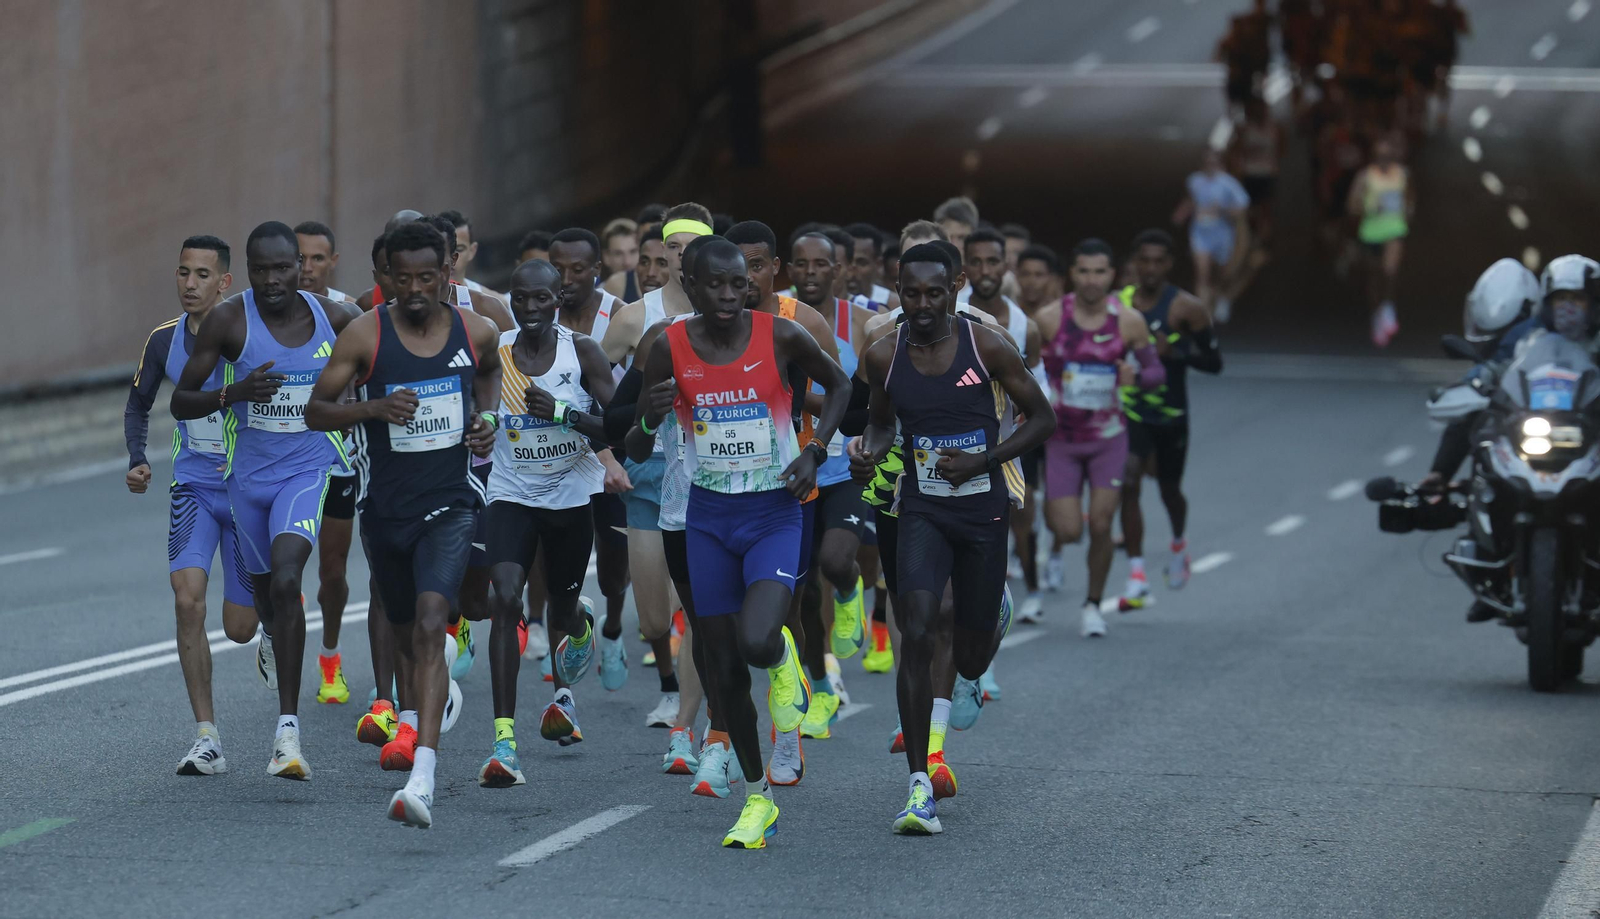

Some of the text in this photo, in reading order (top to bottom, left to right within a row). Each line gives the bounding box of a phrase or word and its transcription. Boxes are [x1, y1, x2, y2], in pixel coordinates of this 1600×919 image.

[696, 387, 758, 406] SEVILLA
[421, 406, 432, 415] 25
[716, 407, 758, 419] ZURICH
[406, 416, 450, 435] SHUMI
[536, 434, 548, 443] 23
[725, 430, 736, 438] 55
[937, 436, 977, 447] ZURICH
[514, 441, 576, 459] SOLOMON
[710, 441, 755, 456] PACER
